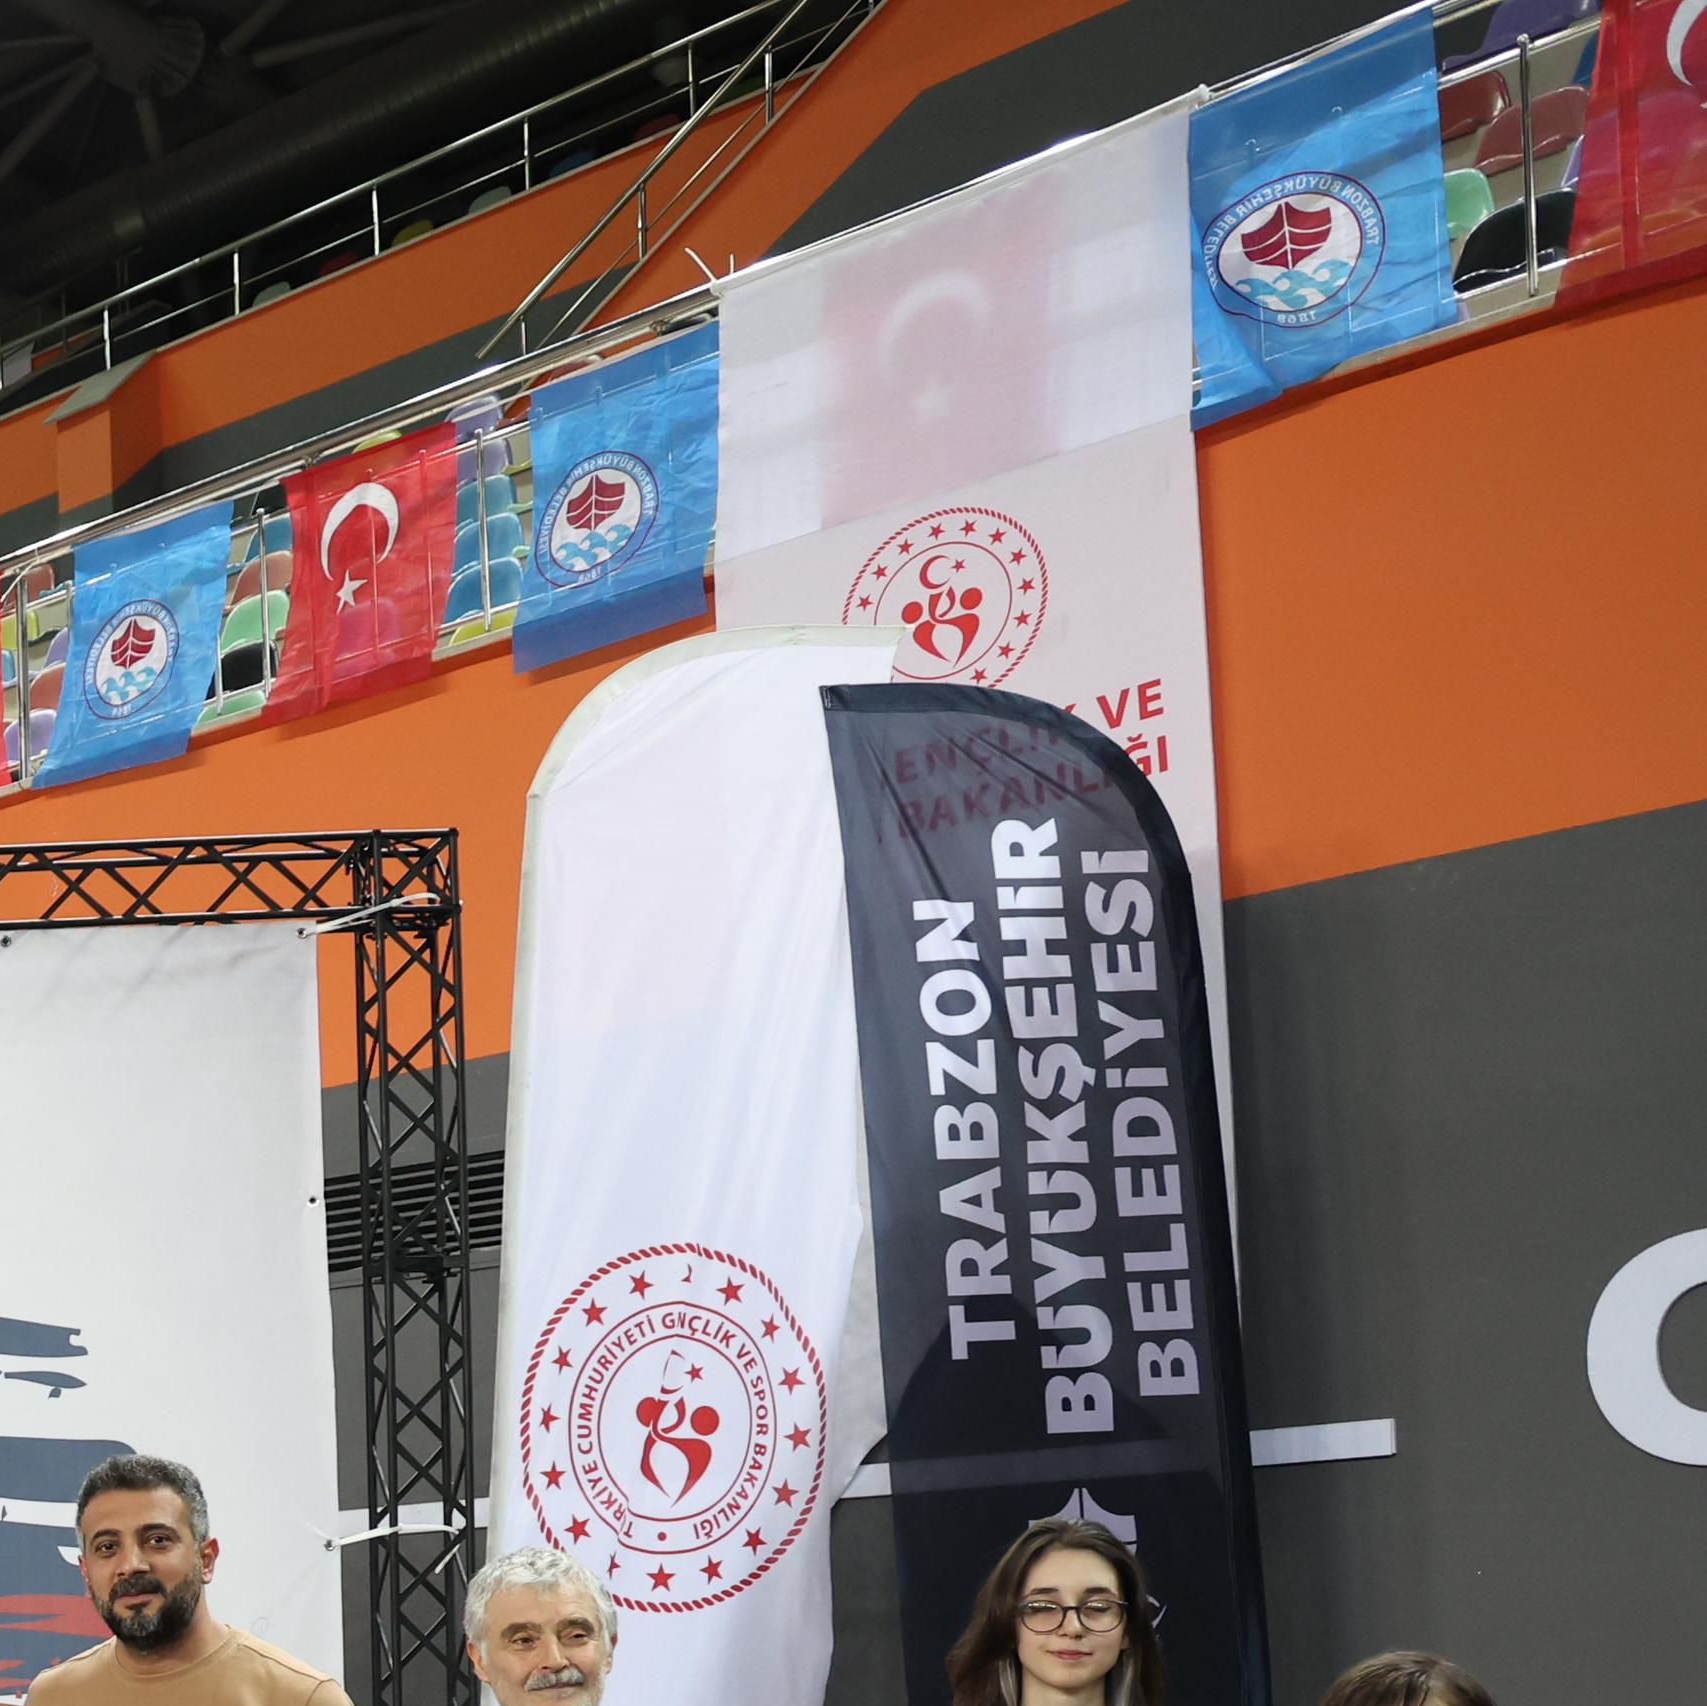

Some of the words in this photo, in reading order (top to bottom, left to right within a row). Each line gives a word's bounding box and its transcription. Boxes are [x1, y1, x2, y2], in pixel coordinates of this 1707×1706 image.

[1097, 678, 1165, 730] VE
[912, 899, 1017, 1361] TRABZON
[990, 816, 1116, 1435] BÜYÜKŞEHİR
[1080, 849, 1201, 1397] BELEDİYESİ
[577, 1314, 656, 1455] CUMHURİYETİ
[736, 1343, 758, 1374] VE
[751, 1375, 769, 1437] SPOR
[693, 1442, 768, 1540] BAKANLIĞI
